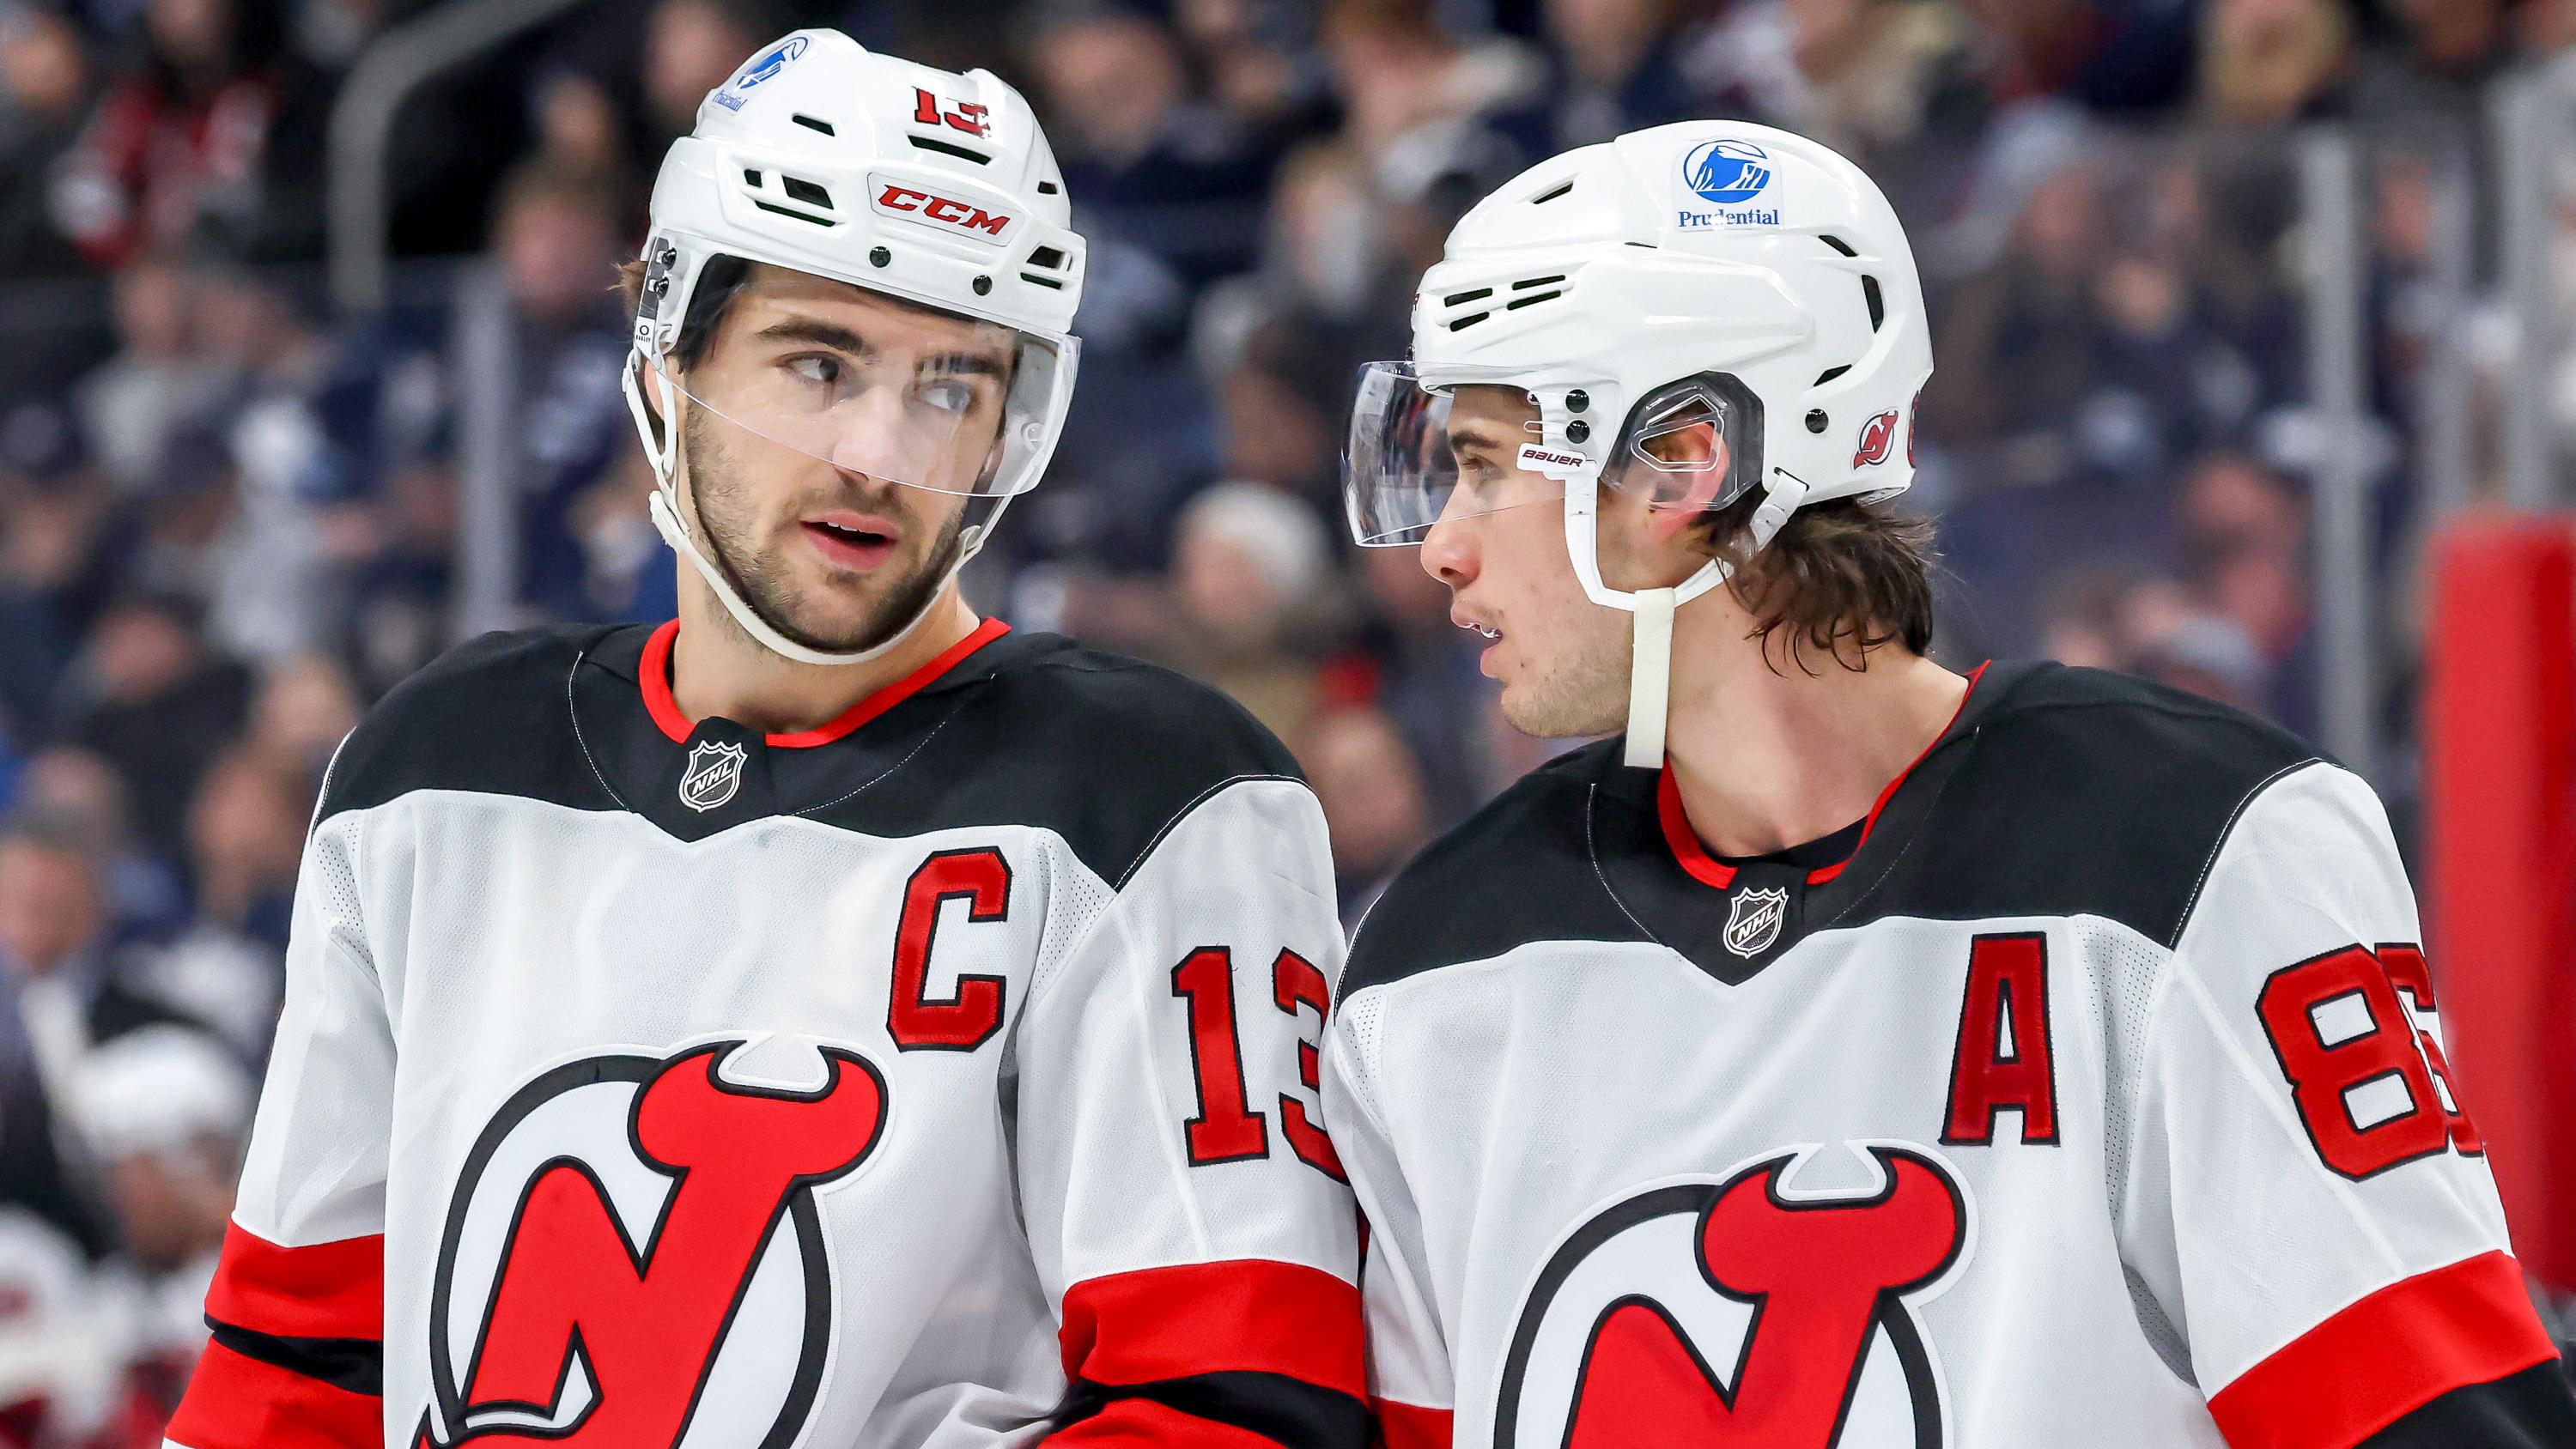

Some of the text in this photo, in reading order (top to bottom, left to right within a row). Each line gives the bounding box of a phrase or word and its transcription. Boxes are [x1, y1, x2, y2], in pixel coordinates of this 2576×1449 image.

[878, 184, 1011, 236] CCM
[691, 761, 733, 796] NHL
[887, 845, 1012, 1052] C
[1736, 906, 1777, 943] NHL
[1170, 945, 1352, 1186] 13
[1941, 931, 2060, 1147] A
